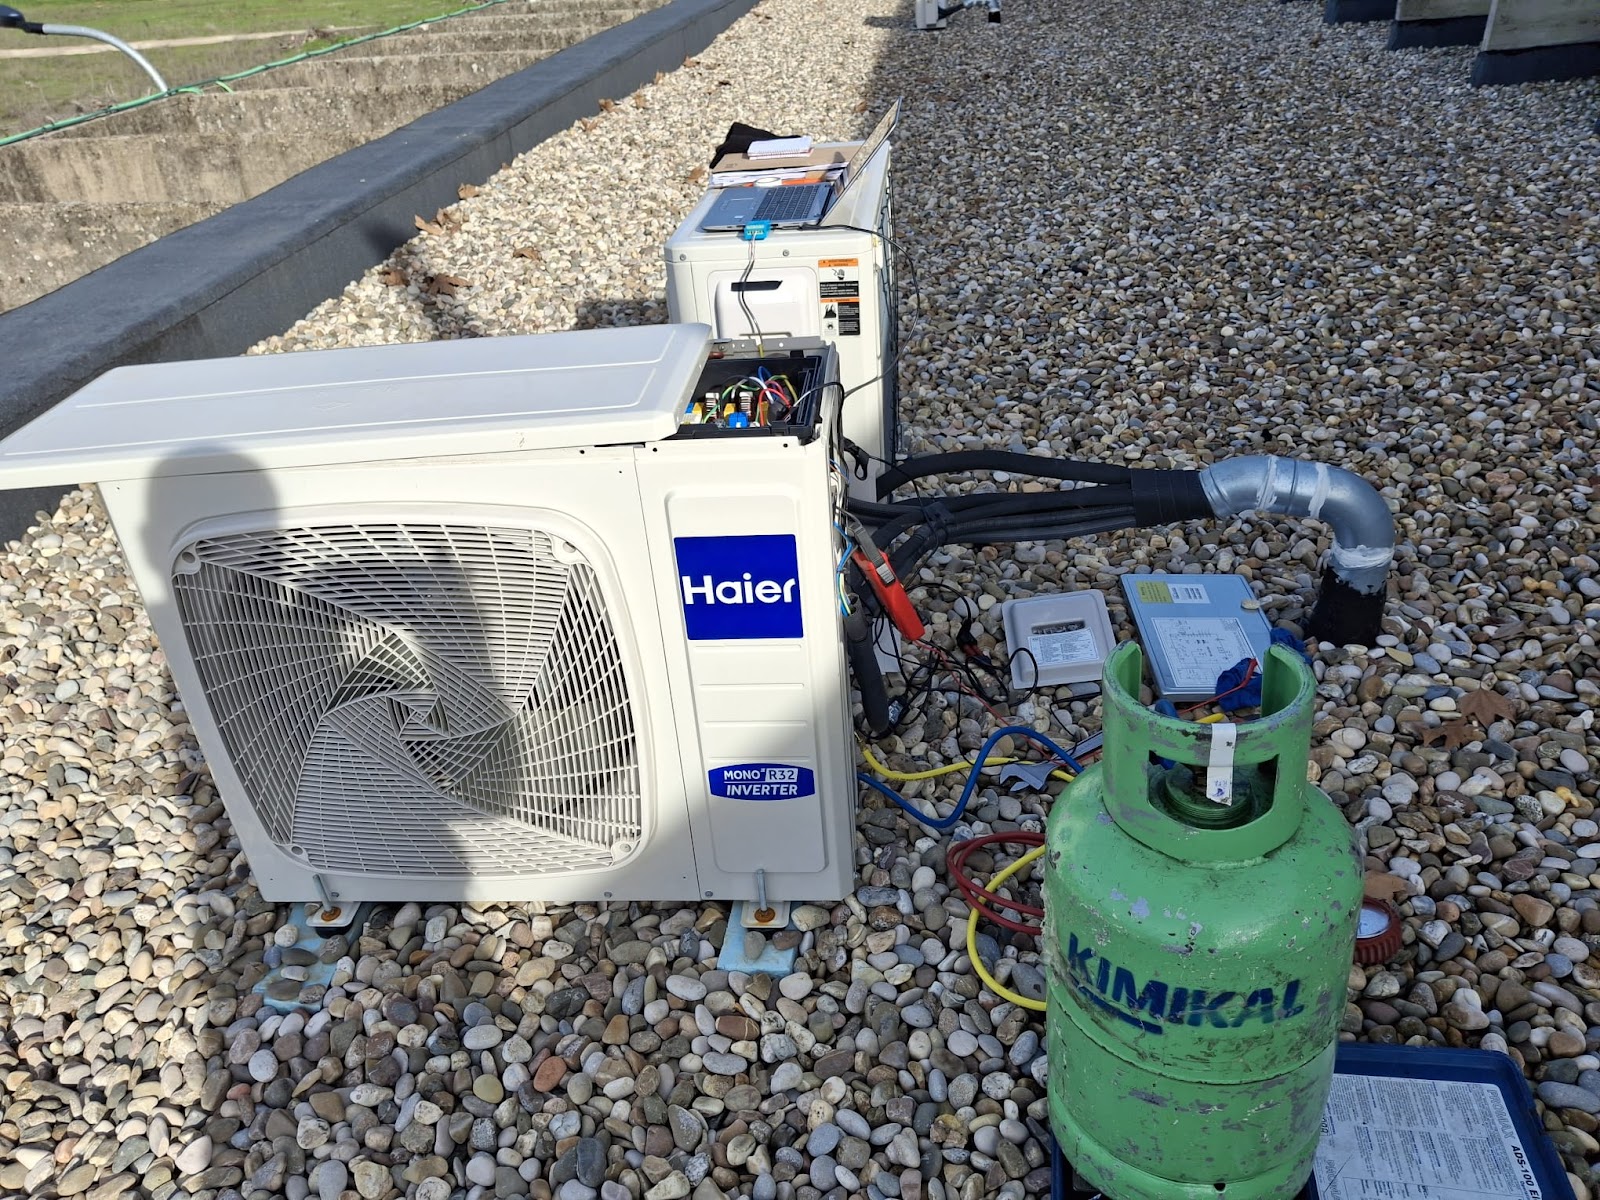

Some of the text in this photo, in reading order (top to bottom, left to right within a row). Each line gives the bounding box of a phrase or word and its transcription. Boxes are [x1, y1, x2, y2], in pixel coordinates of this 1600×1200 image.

[682, 572, 796, 605] Haier
[723, 768, 796, 781] MONO R32
[726, 784, 798, 797] INVERTER
[1068, 932, 1304, 1029] KIMIKAL
[1511, 1145, 1535, 1187] ADS-100
